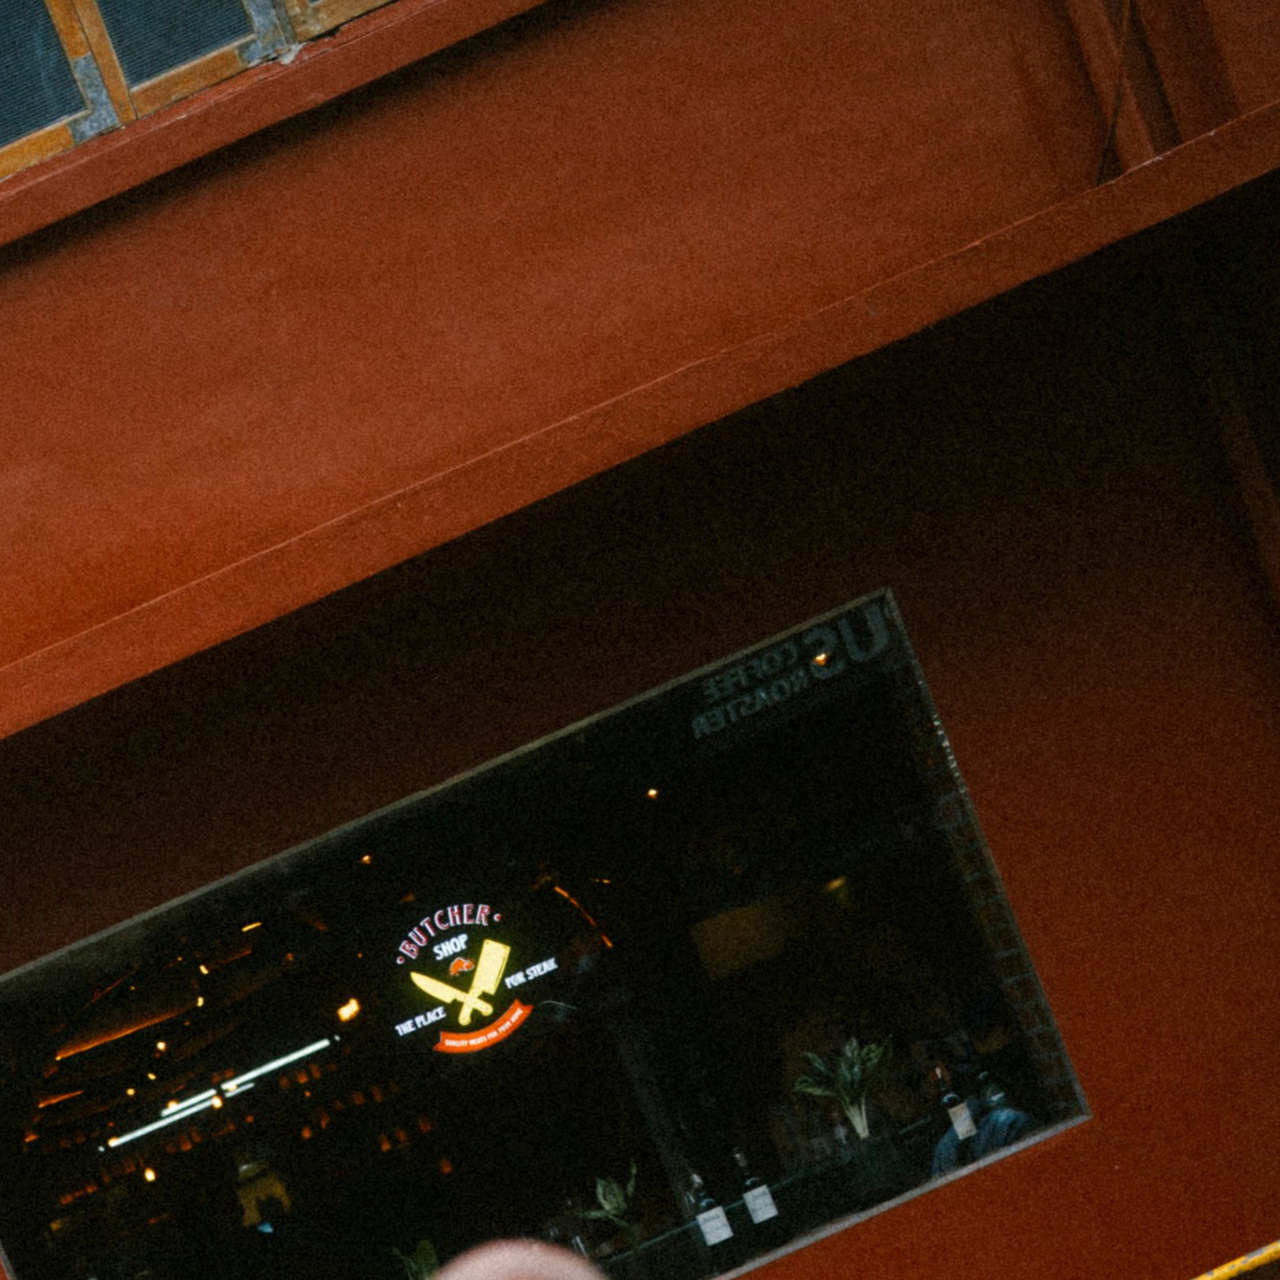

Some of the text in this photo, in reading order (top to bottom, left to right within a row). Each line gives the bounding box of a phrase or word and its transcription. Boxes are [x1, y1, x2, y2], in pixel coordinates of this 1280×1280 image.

[399, 903, 491, 959] BUTCHER
[432, 933, 468, 961] SHOP
[394, 957, 558, 1036] THE PLACE FOR STEAK
